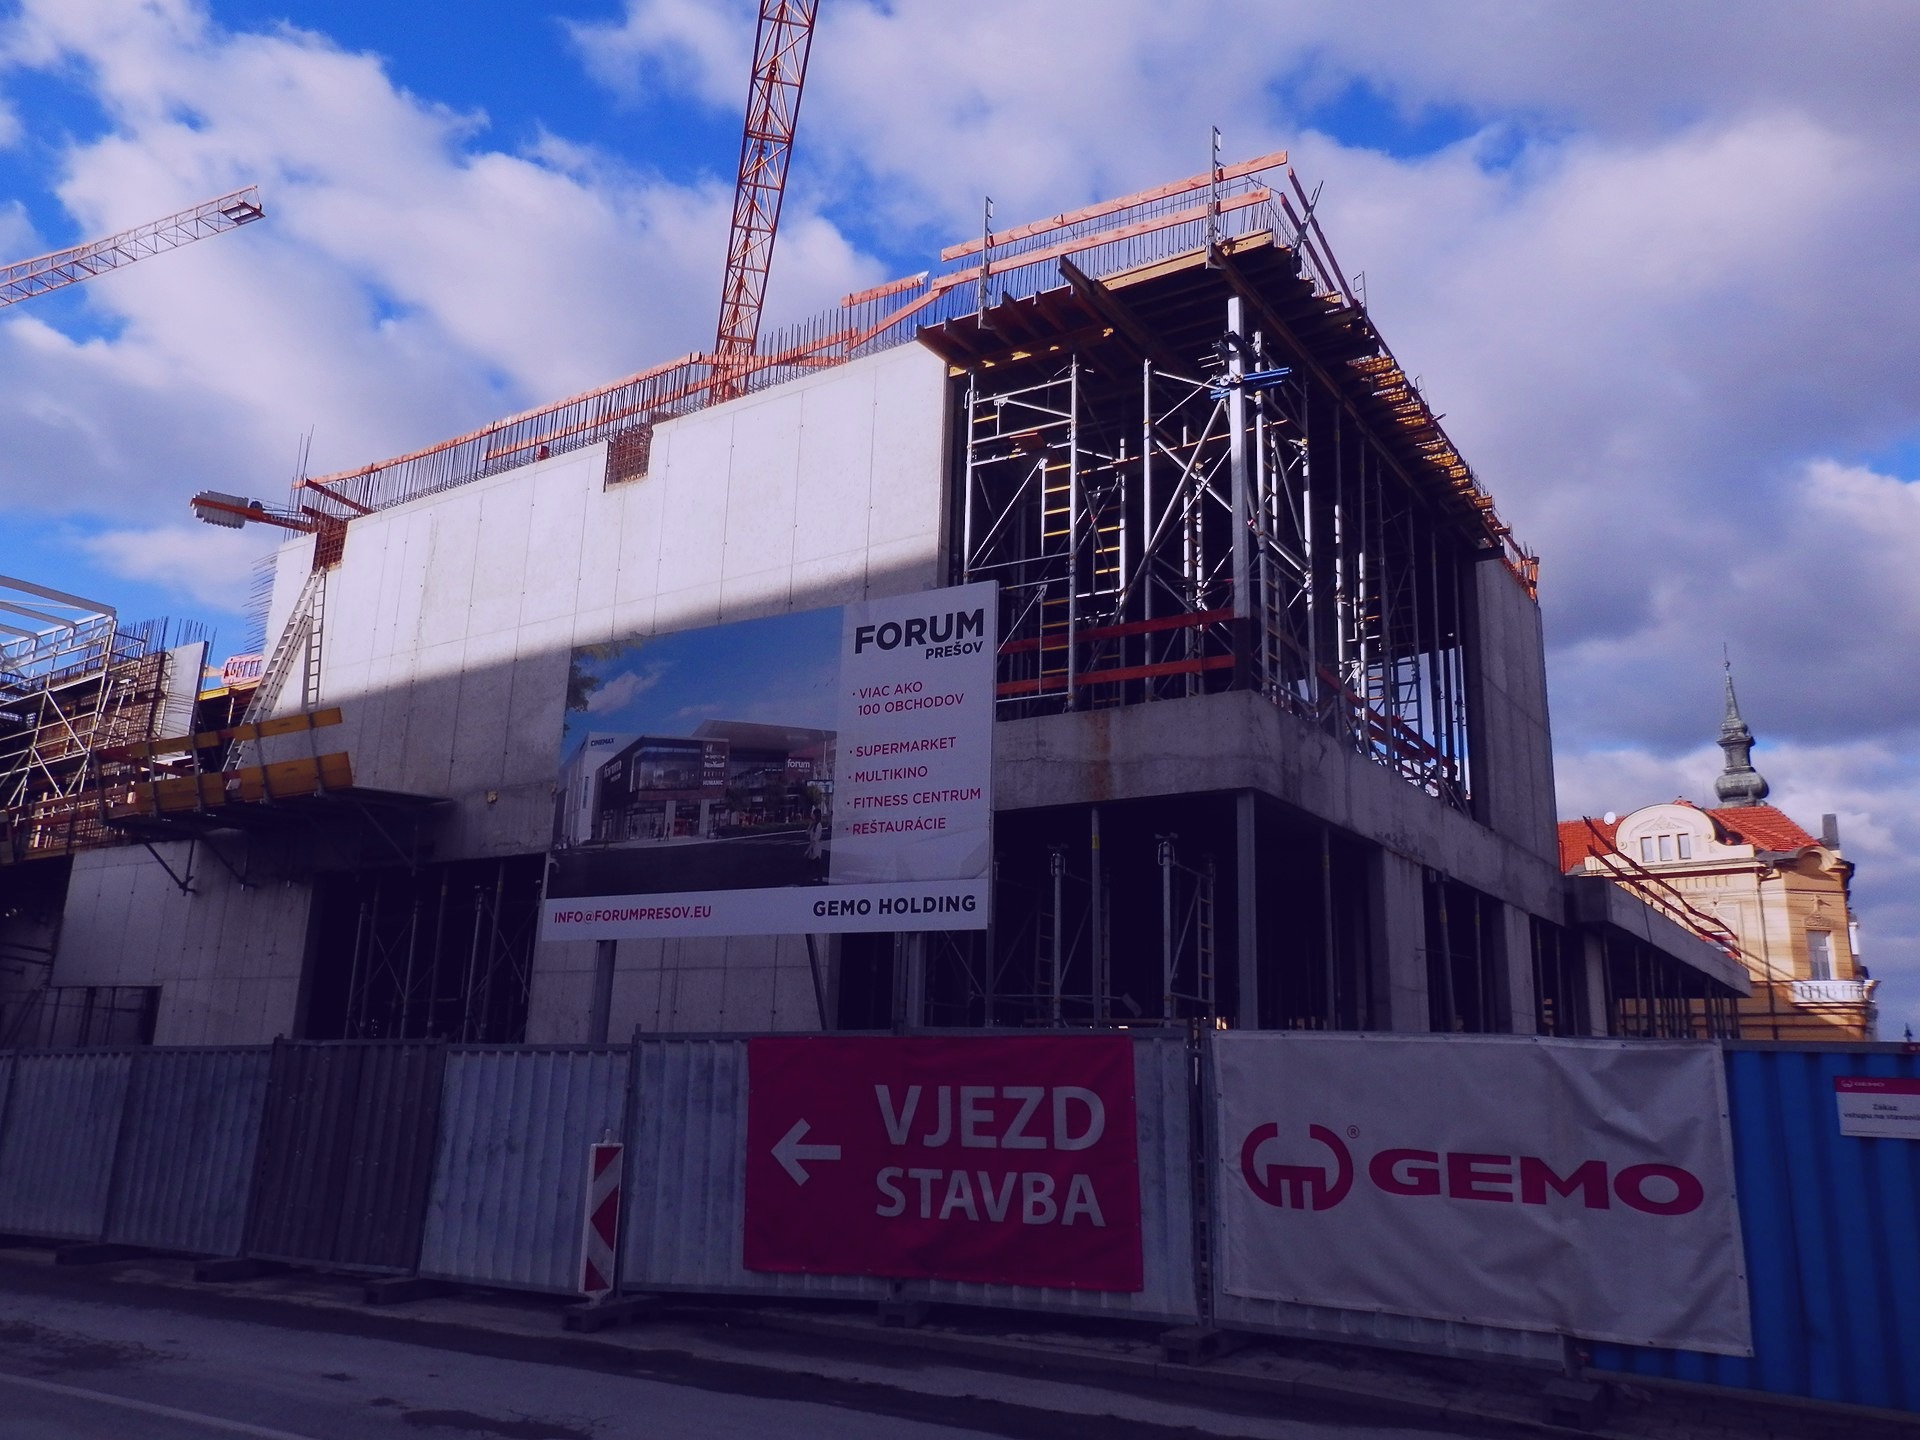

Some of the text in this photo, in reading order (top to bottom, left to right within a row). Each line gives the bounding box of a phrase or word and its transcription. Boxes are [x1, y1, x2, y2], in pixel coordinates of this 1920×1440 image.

[855, 608, 984, 654] FORUM
[925, 641, 983, 659] PREŠOV
[859, 681, 923, 699] VIAC AKO
[858, 693, 964, 716] 100 OBCHODOV
[856, 736, 957, 757] SUPERMARKET
[787, 758, 810, 768] forum
[855, 765, 928, 783] MULTIKINO
[853, 787, 981, 809] FITNESS CENTRUM
[852, 816, 946, 835] REŠTAURÁCIE
[554, 905, 712, 925] INFO@FORUMPRESOV.EU
[813, 894, 977, 917] GEMO HOLDING
[874, 1084, 1106, 1151] VJEZD
[1369, 1148, 1704, 1216] GEMO
[875, 1166, 1107, 1228] STAVBA
